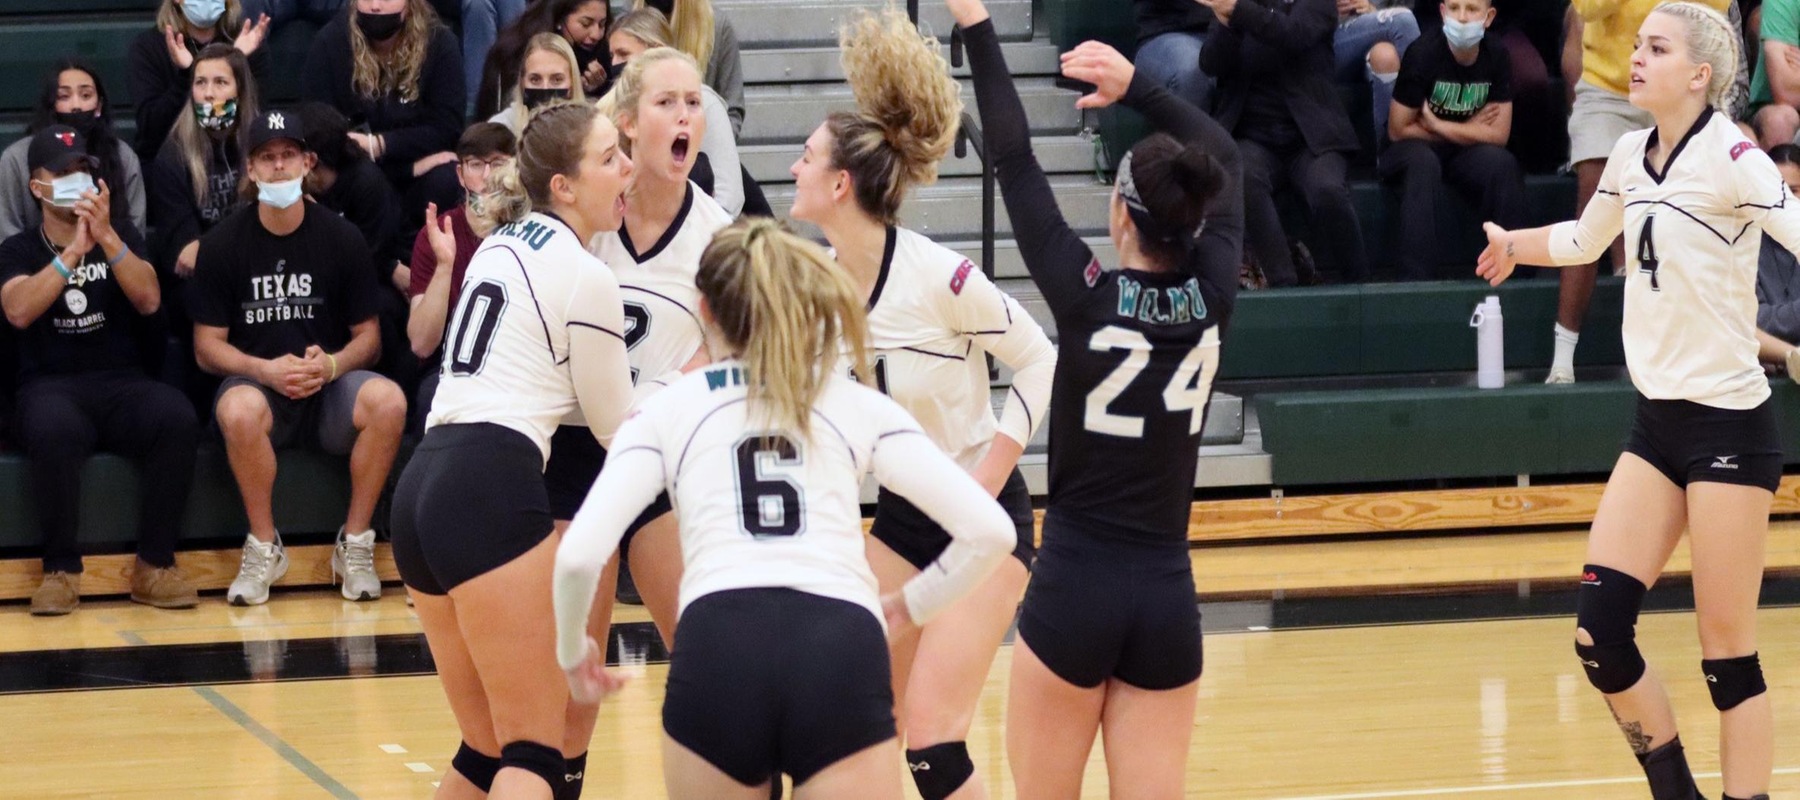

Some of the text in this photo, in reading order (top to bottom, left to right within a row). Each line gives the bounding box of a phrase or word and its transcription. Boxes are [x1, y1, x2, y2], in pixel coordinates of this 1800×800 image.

[1430, 81, 1489, 111] WILMU
[268, 112, 285, 129] NY
[1636, 212, 1660, 291] 4
[251, 273, 312, 300] TEXAS
[1117, 275, 1207, 325] WILMU
[54, 311, 105, 328] BLACK BARREL
[246, 305, 314, 324] SOFTBALL
[1084, 323, 1221, 438] 24
[731, 430, 806, 541] 6
